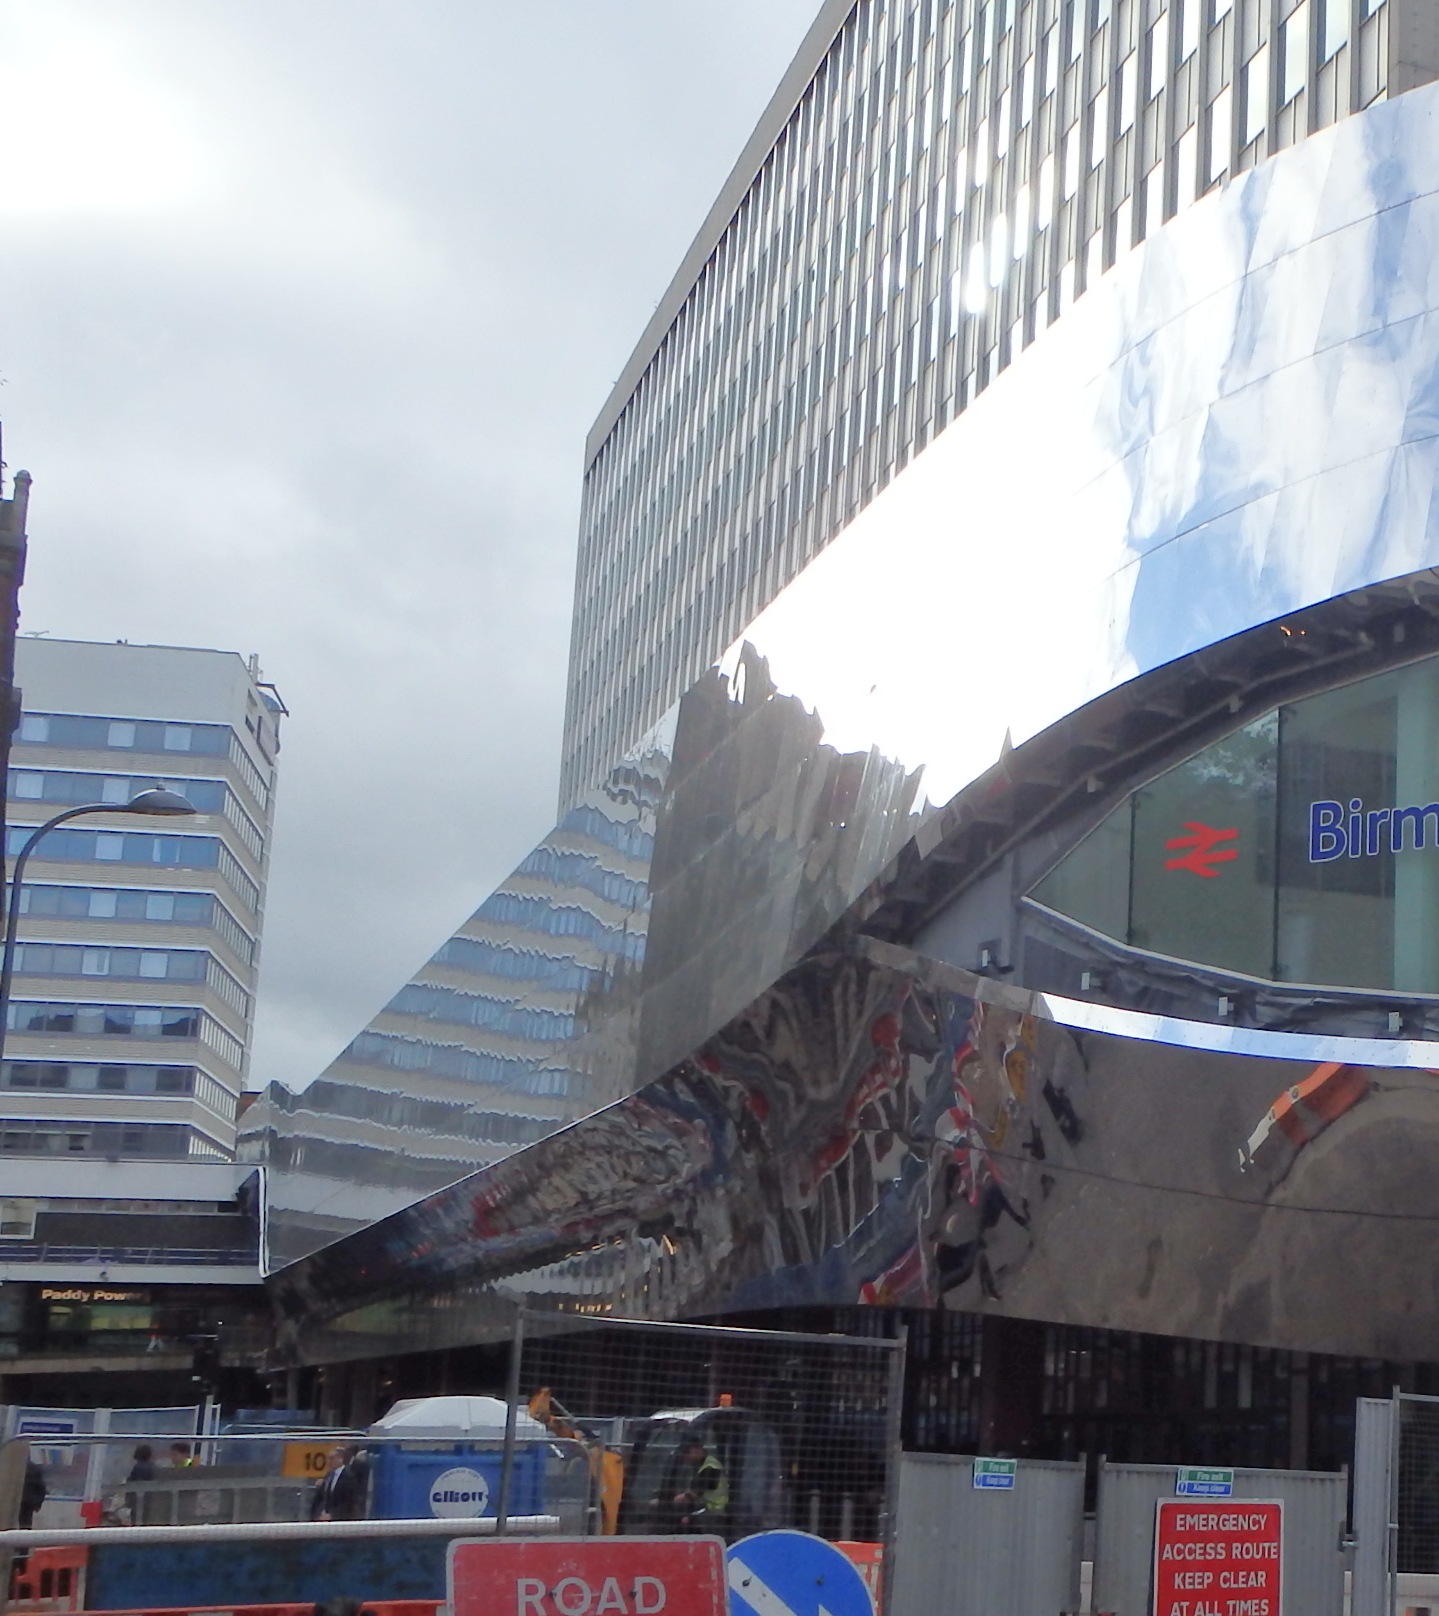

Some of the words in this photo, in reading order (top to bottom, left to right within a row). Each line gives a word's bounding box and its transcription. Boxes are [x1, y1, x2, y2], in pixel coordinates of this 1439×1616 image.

[41, 1289, 90, 1302] Paddy
[1175, 1513, 1268, 1531] EMERGENCY
[1162, 1543, 1227, 1560] ACCESS
[1231, 1542, 1278, 1559] ROUTE
[1174, 1572, 1214, 1589] KEEP
[1219, 1571, 1267, 1588] CLEAR
[516, 1576, 667, 1616] ROAD
[1170, 1601, 1190, 1616] AT
[1194, 1600, 1222, 1616] ALL
[1226, 1599, 1269, 1616] TIMES
